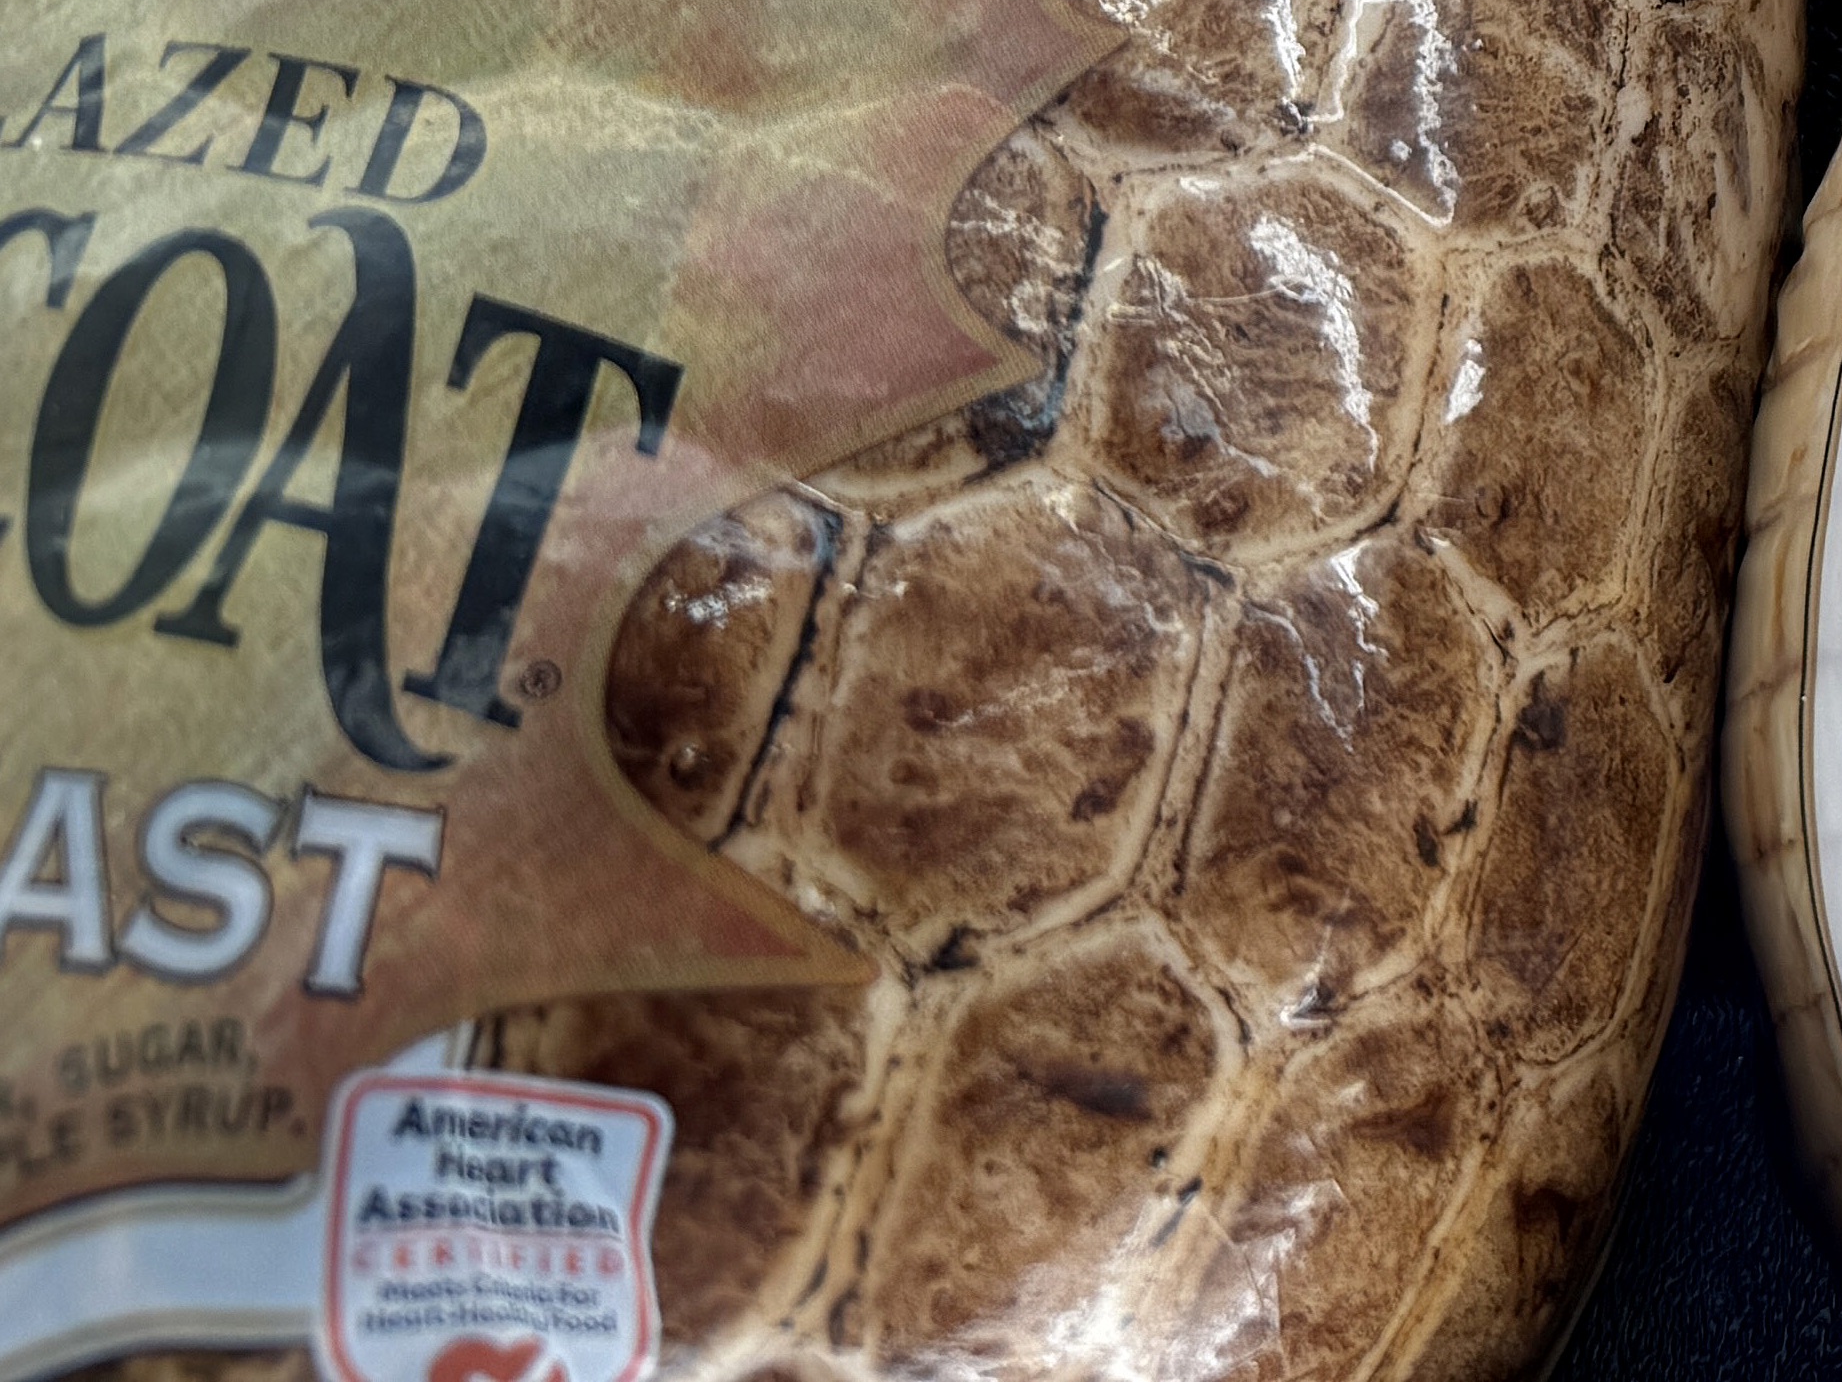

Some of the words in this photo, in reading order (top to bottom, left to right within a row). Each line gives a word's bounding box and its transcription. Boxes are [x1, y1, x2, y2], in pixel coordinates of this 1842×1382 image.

[0, 32, 488, 204] AZED
[396, 1095, 603, 1155] American
[435, 1145, 557, 1187] Heart
[358, 1186, 620, 1235] Association
[350, 1241, 626, 1277] CERTIFIED
